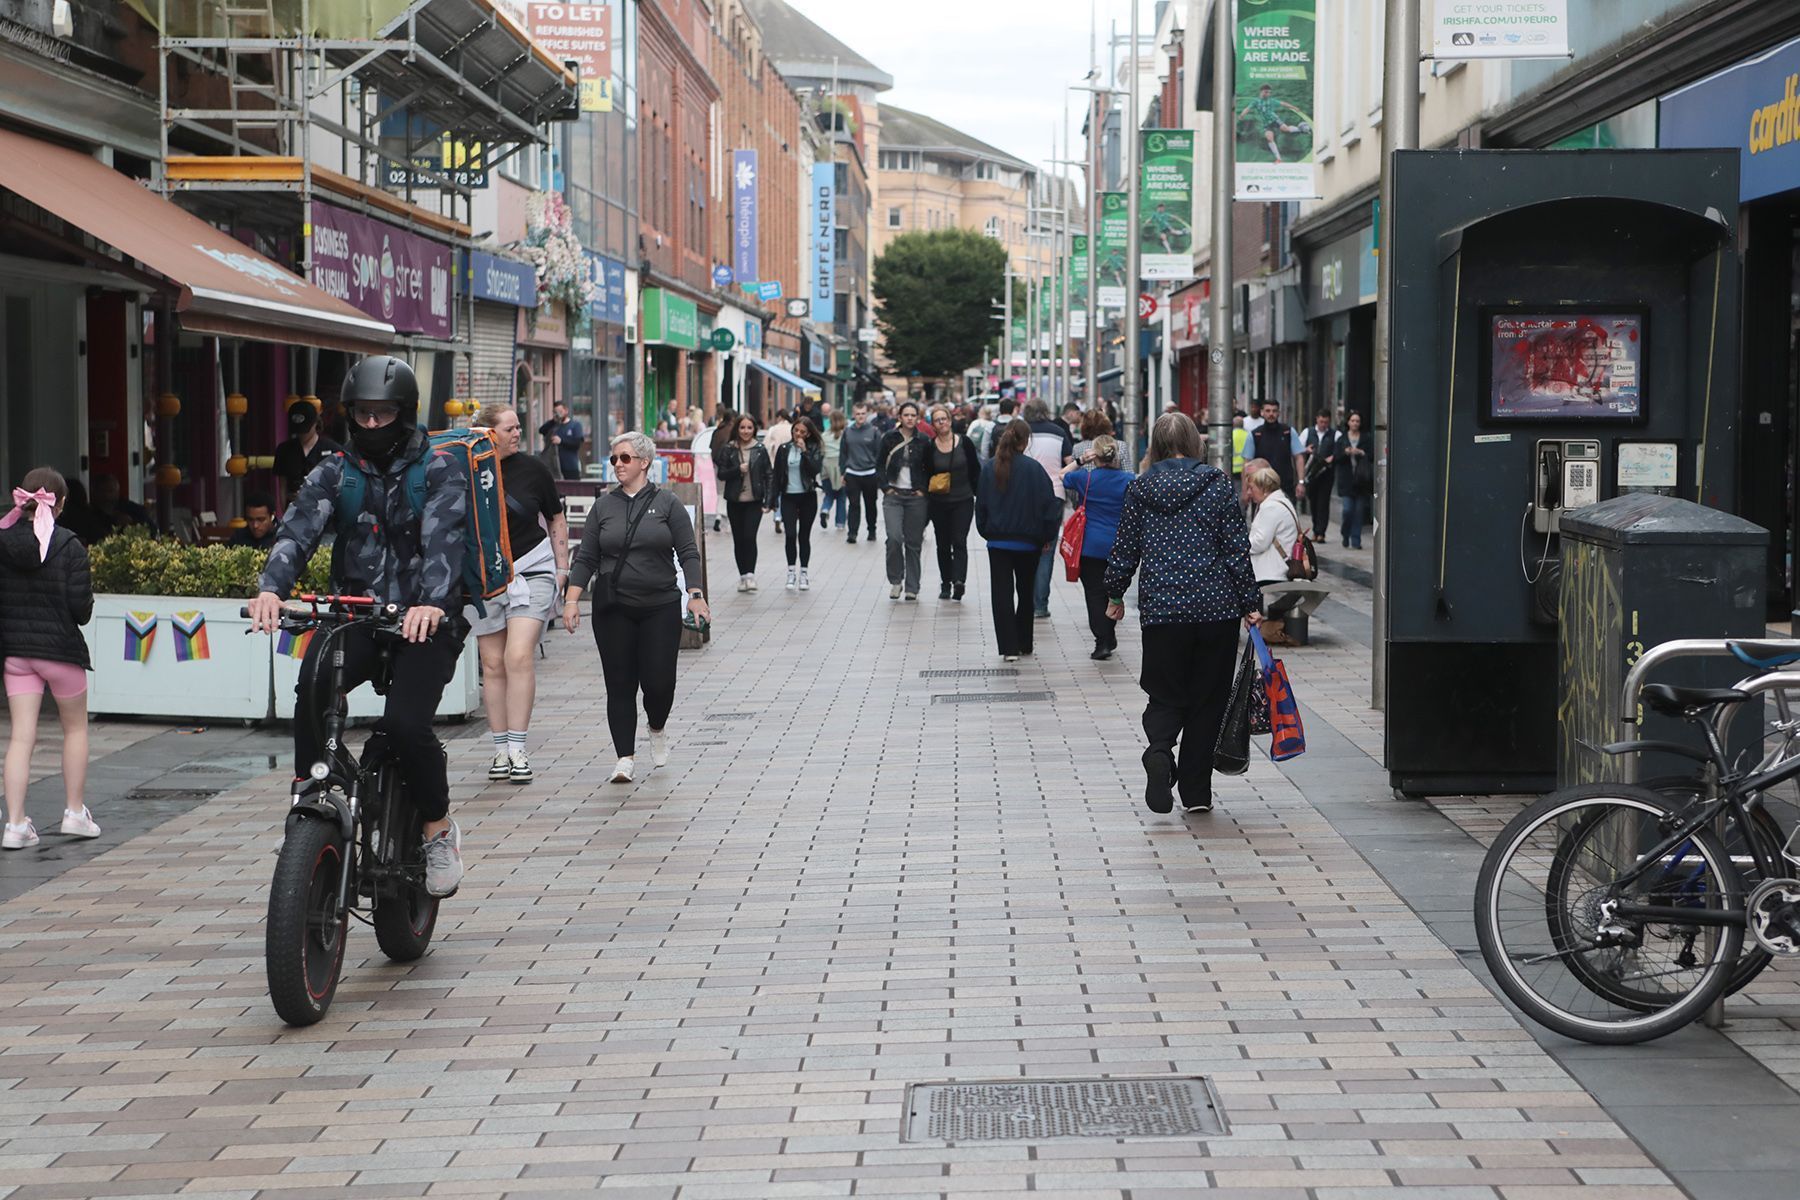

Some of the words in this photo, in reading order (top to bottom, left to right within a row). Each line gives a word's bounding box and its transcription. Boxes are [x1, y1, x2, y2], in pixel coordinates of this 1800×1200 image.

[534, 5, 564, 20] TO
[569, 6, 605, 21] LET
[1454, 4, 1469, 14] GET
[1475, 4, 1502, 14] YOUR
[1506, 3, 1544, 13] TICKETS
[1443, 15, 1557, 25] IRISHFA.COM/U19EURO
[536, 25, 604, 38] REFURBISHED
[1244, 26, 1289, 37] WHERE
[571, 40, 606, 52] SUITES
[1243, 39, 1300, 49] LEGENDS
[1243, 51, 1268, 62] ARE
[1271, 51, 1310, 62] MADE.
[819, 186, 829, 238] NERO
[325, 269, 349, 300] USUAL
